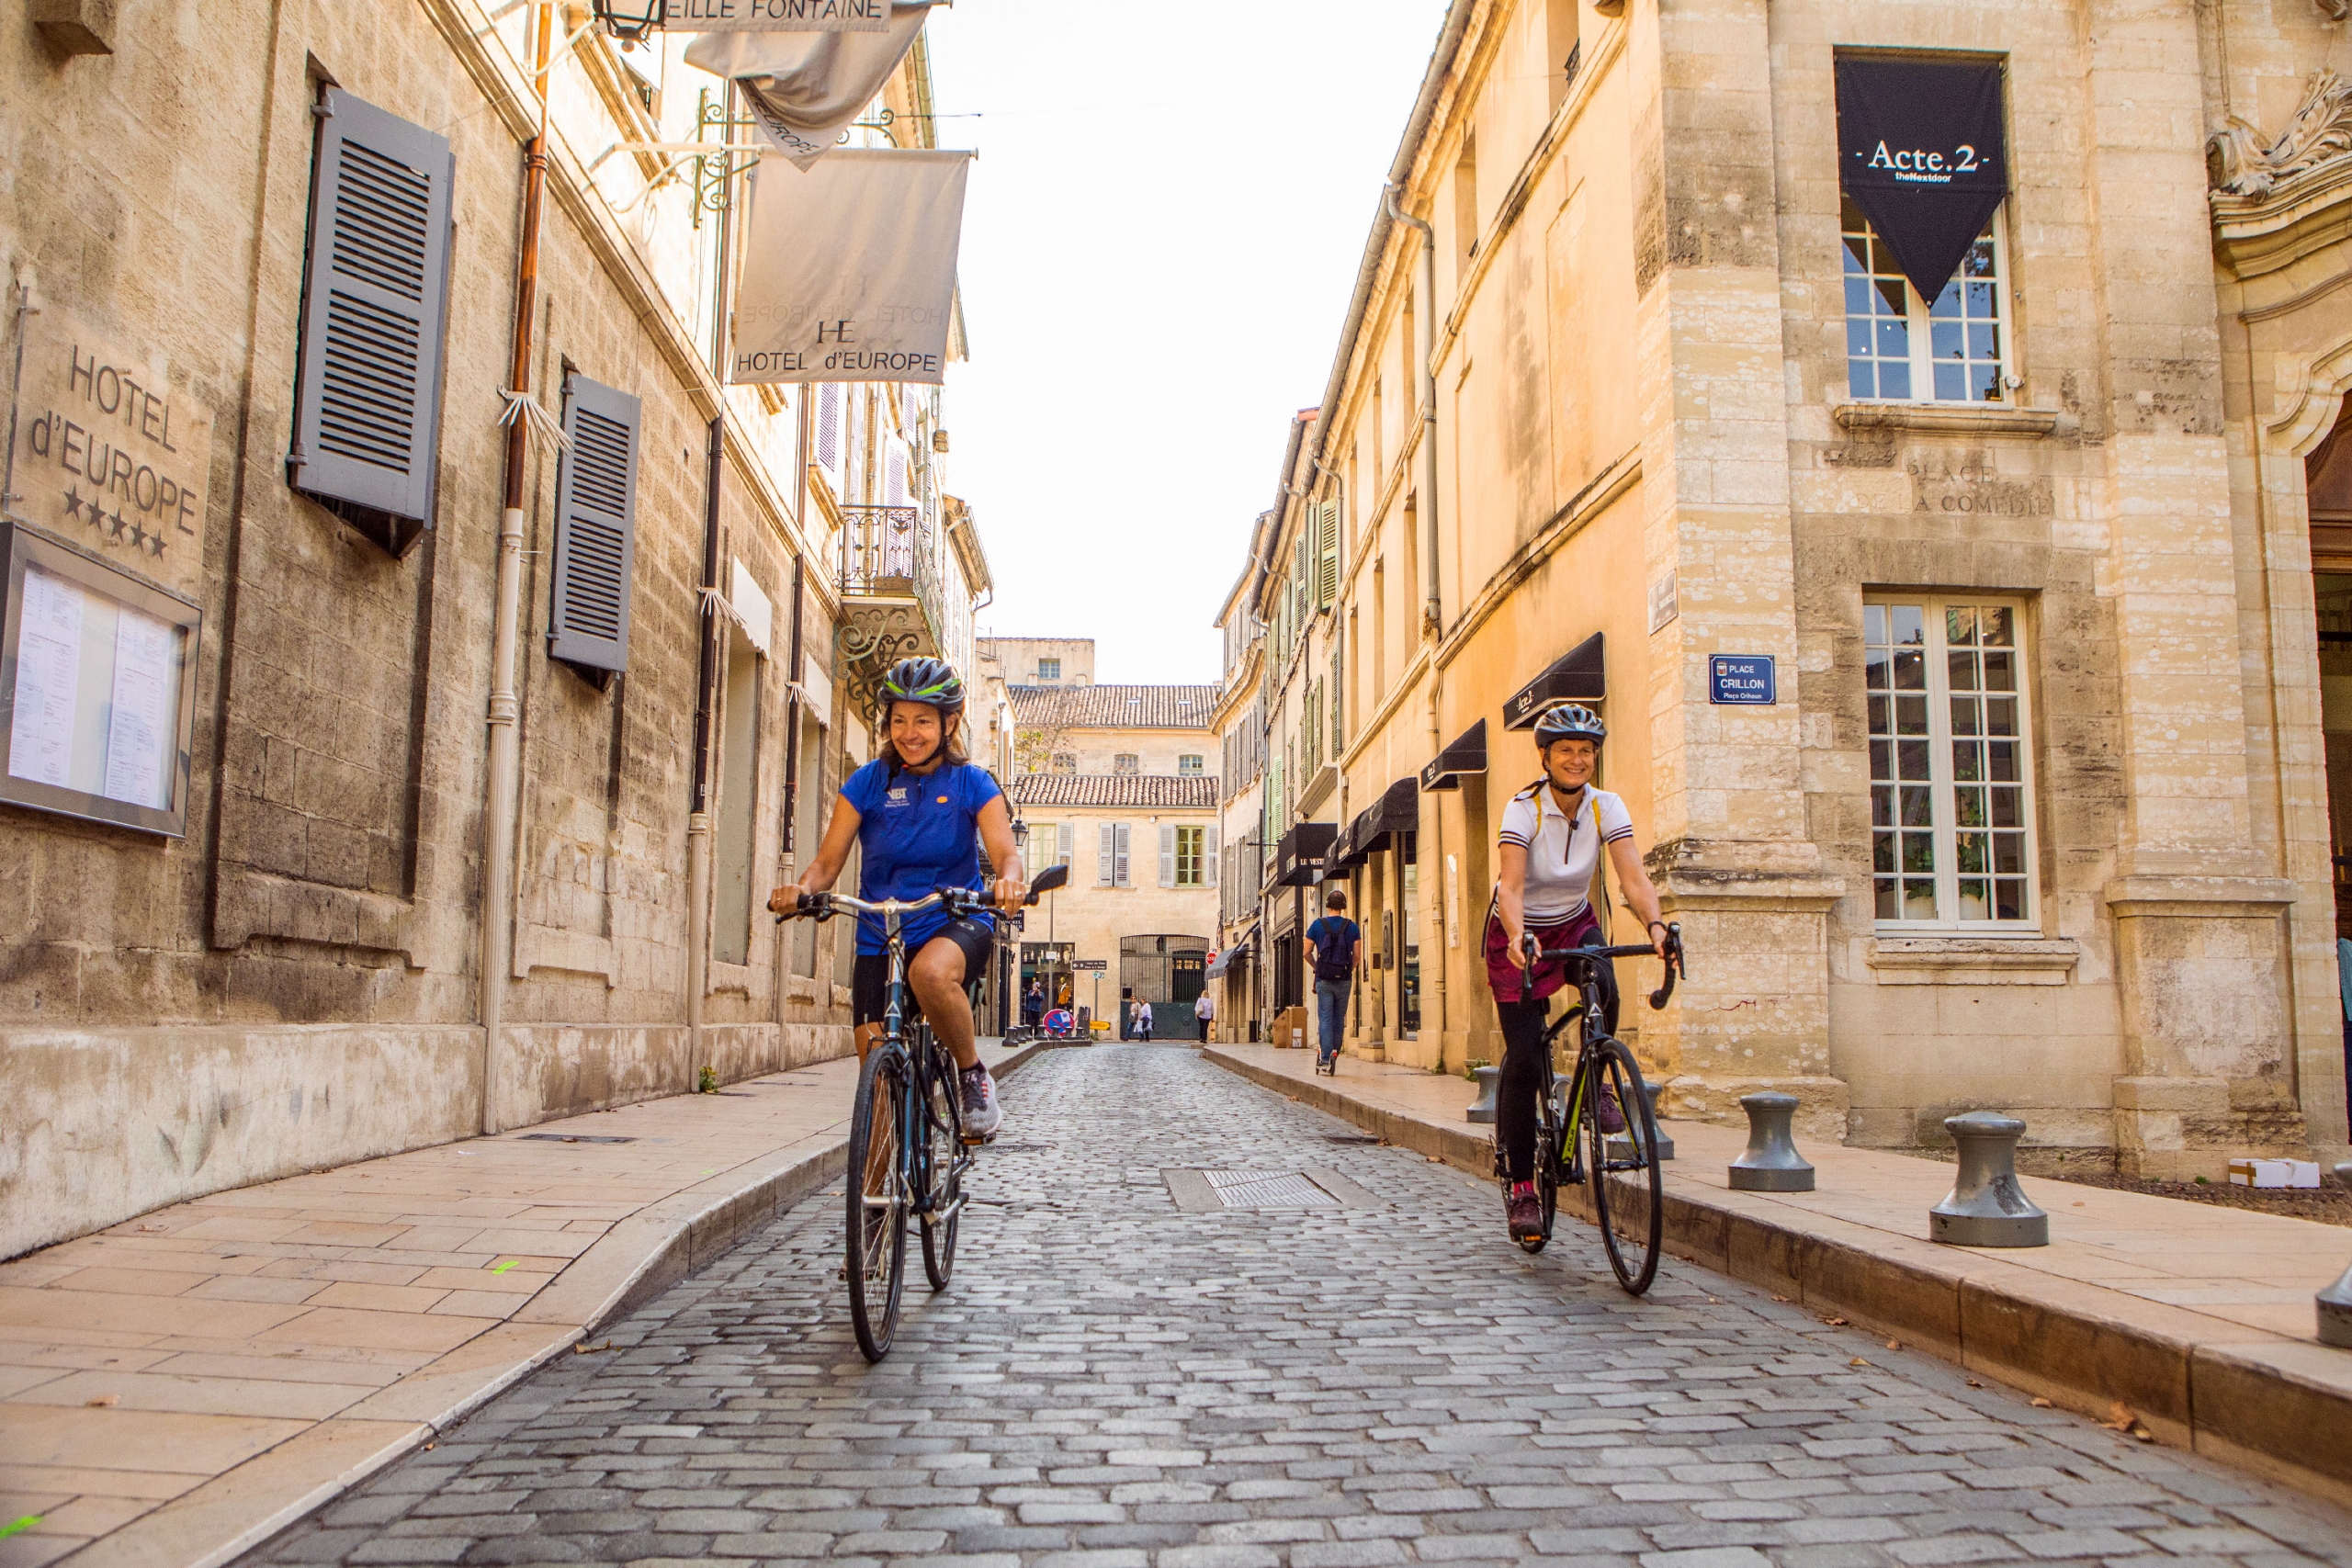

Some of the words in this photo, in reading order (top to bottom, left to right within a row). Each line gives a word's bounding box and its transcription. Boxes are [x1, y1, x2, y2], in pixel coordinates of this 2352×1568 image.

[752, 0, 883, 18] FONTAINE
[738, 352, 808, 372] HOTEL
[825, 351, 938, 373] d'EUROPE
[71, 344, 177, 454] HOTEL
[31, 410, 198, 536] d'EUROPE
[1905, 463, 1994, 483] PLACE
[1729, 665, 1755, 673] PLACE
[1720, 679, 1765, 689] CRILLON
